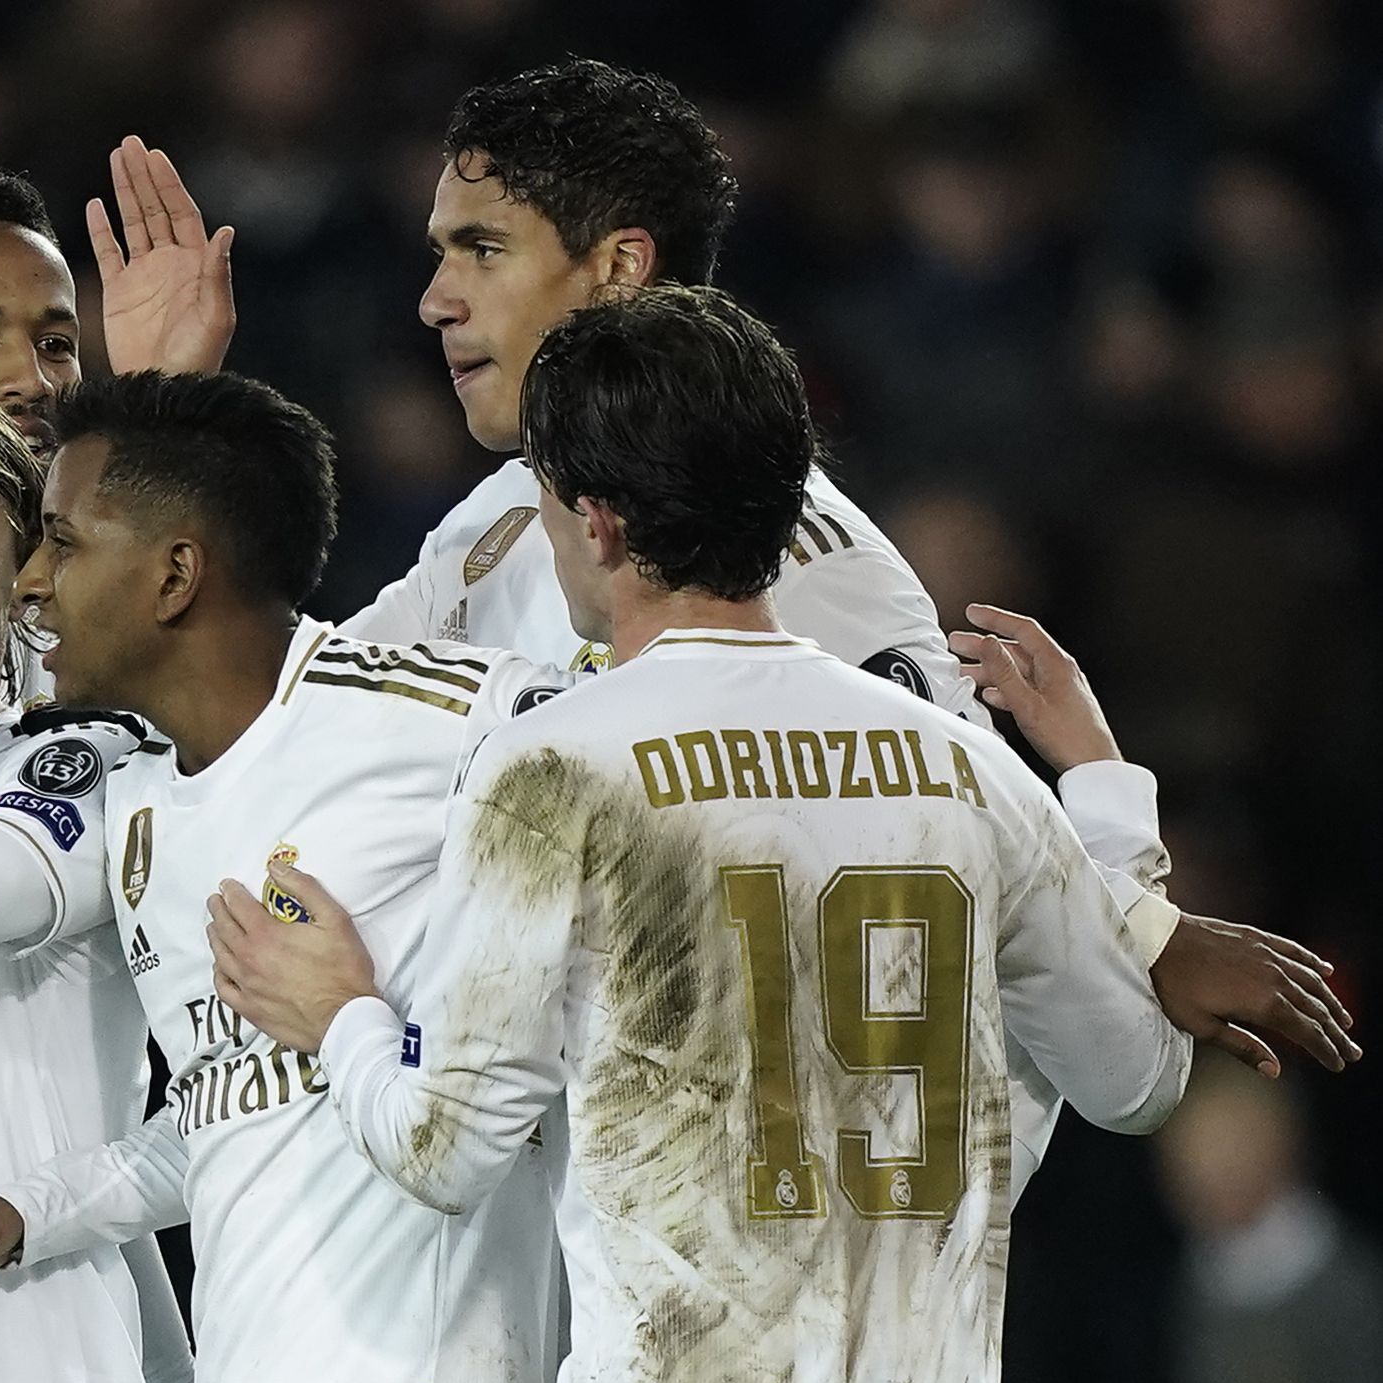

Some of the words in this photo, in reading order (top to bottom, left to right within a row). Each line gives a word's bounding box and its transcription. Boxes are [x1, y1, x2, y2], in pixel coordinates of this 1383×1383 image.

[39, 762, 74, 781] 13
[632, 728, 989, 809] ODRIOZOLA
[185, 994, 243, 1051] Fly
[718, 864, 976, 1220] 19
